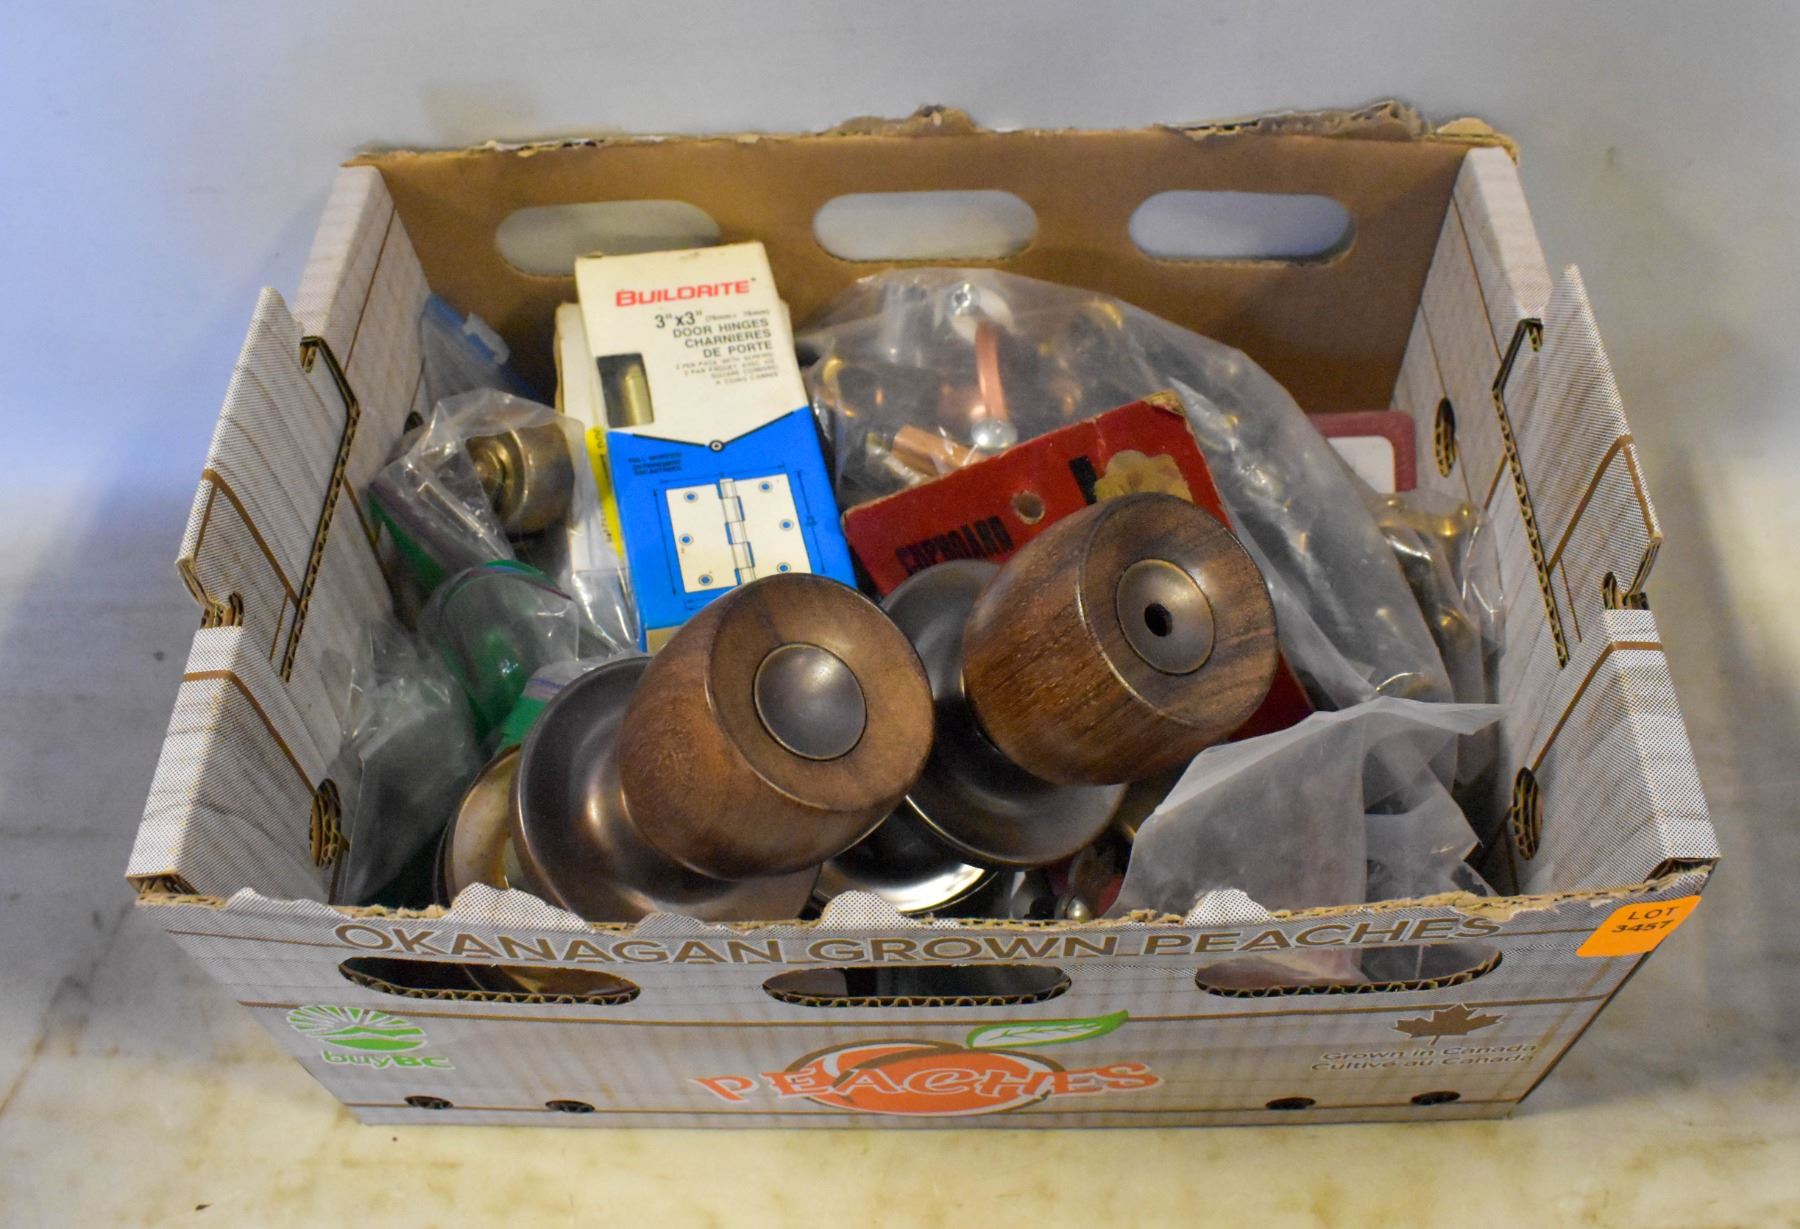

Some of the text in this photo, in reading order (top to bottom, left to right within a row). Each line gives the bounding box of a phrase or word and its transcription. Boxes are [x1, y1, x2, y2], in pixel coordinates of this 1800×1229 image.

[615, 280, 750, 307] BUILDRITE
[672, 317, 770, 339] DOOR HINGES
[684, 328, 772, 349] CHARNIERES
[702, 340, 773, 359] DE PORTE
[1627, 906, 1680, 921] LOT
[1611, 919, 1674, 933] 3457
[335, 917, 1501, 963] OKANAGAN GROWN PEACHES
[1323, 1051, 1404, 1061] Grown
[1443, 1045, 1537, 1055] Canada
[1442, 1054, 1534, 1065] Canada
[692, 1063, 1163, 1101] PEACHES
